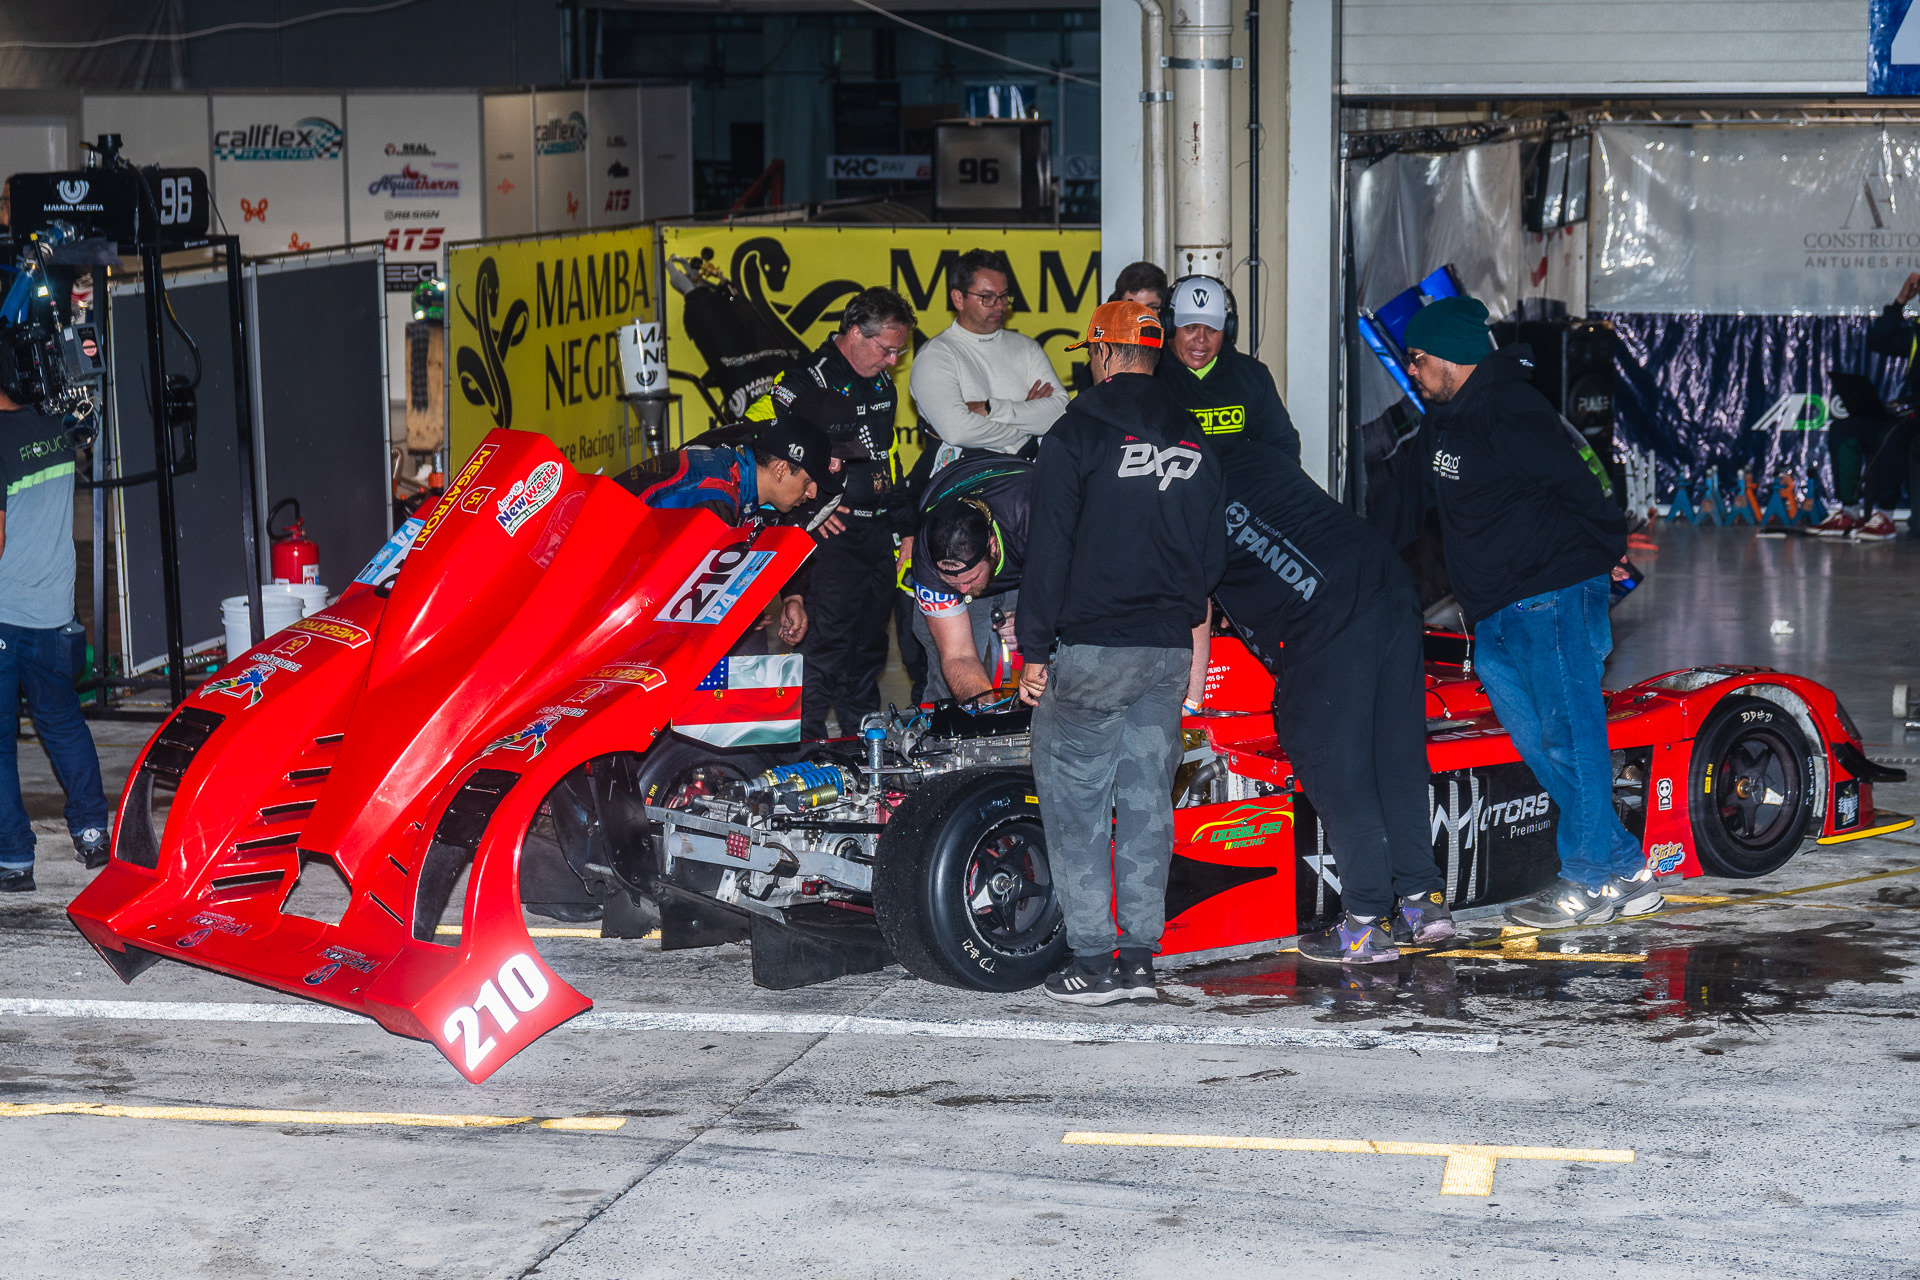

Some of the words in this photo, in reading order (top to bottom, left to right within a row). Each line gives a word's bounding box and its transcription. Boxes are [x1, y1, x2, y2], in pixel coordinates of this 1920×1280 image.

[215, 124, 313, 147] callflex
[833, 158, 878, 176] MRC
[959, 158, 999, 184] 96
[368, 173, 460, 198] Aquatherm
[43, 204, 74, 212] MAMBA
[76, 203, 104, 212] NEGRA
[160, 177, 192, 225] 96
[605, 189, 631, 211] ATS
[384, 227, 445, 251] ATS
[1803, 232, 1920, 248] CONSTRUTO
[1804, 256, 1889, 269] ANTUNES
[536, 247, 650, 329] MAMBA
[579, 429, 615, 461] Racing
[416, 450, 491, 542] MEGATRON
[498, 498, 527, 527] New
[525, 463, 558, 501] World
[390, 520, 421, 547] P4
[1235, 526, 1318, 602] PANDA
[669, 541, 750, 622] 210
[706, 593, 738, 621] P4
[1210, 821, 1283, 843] DOBILAS
[1510, 819, 1551, 839] Premium
[443, 953, 549, 1072] 210
